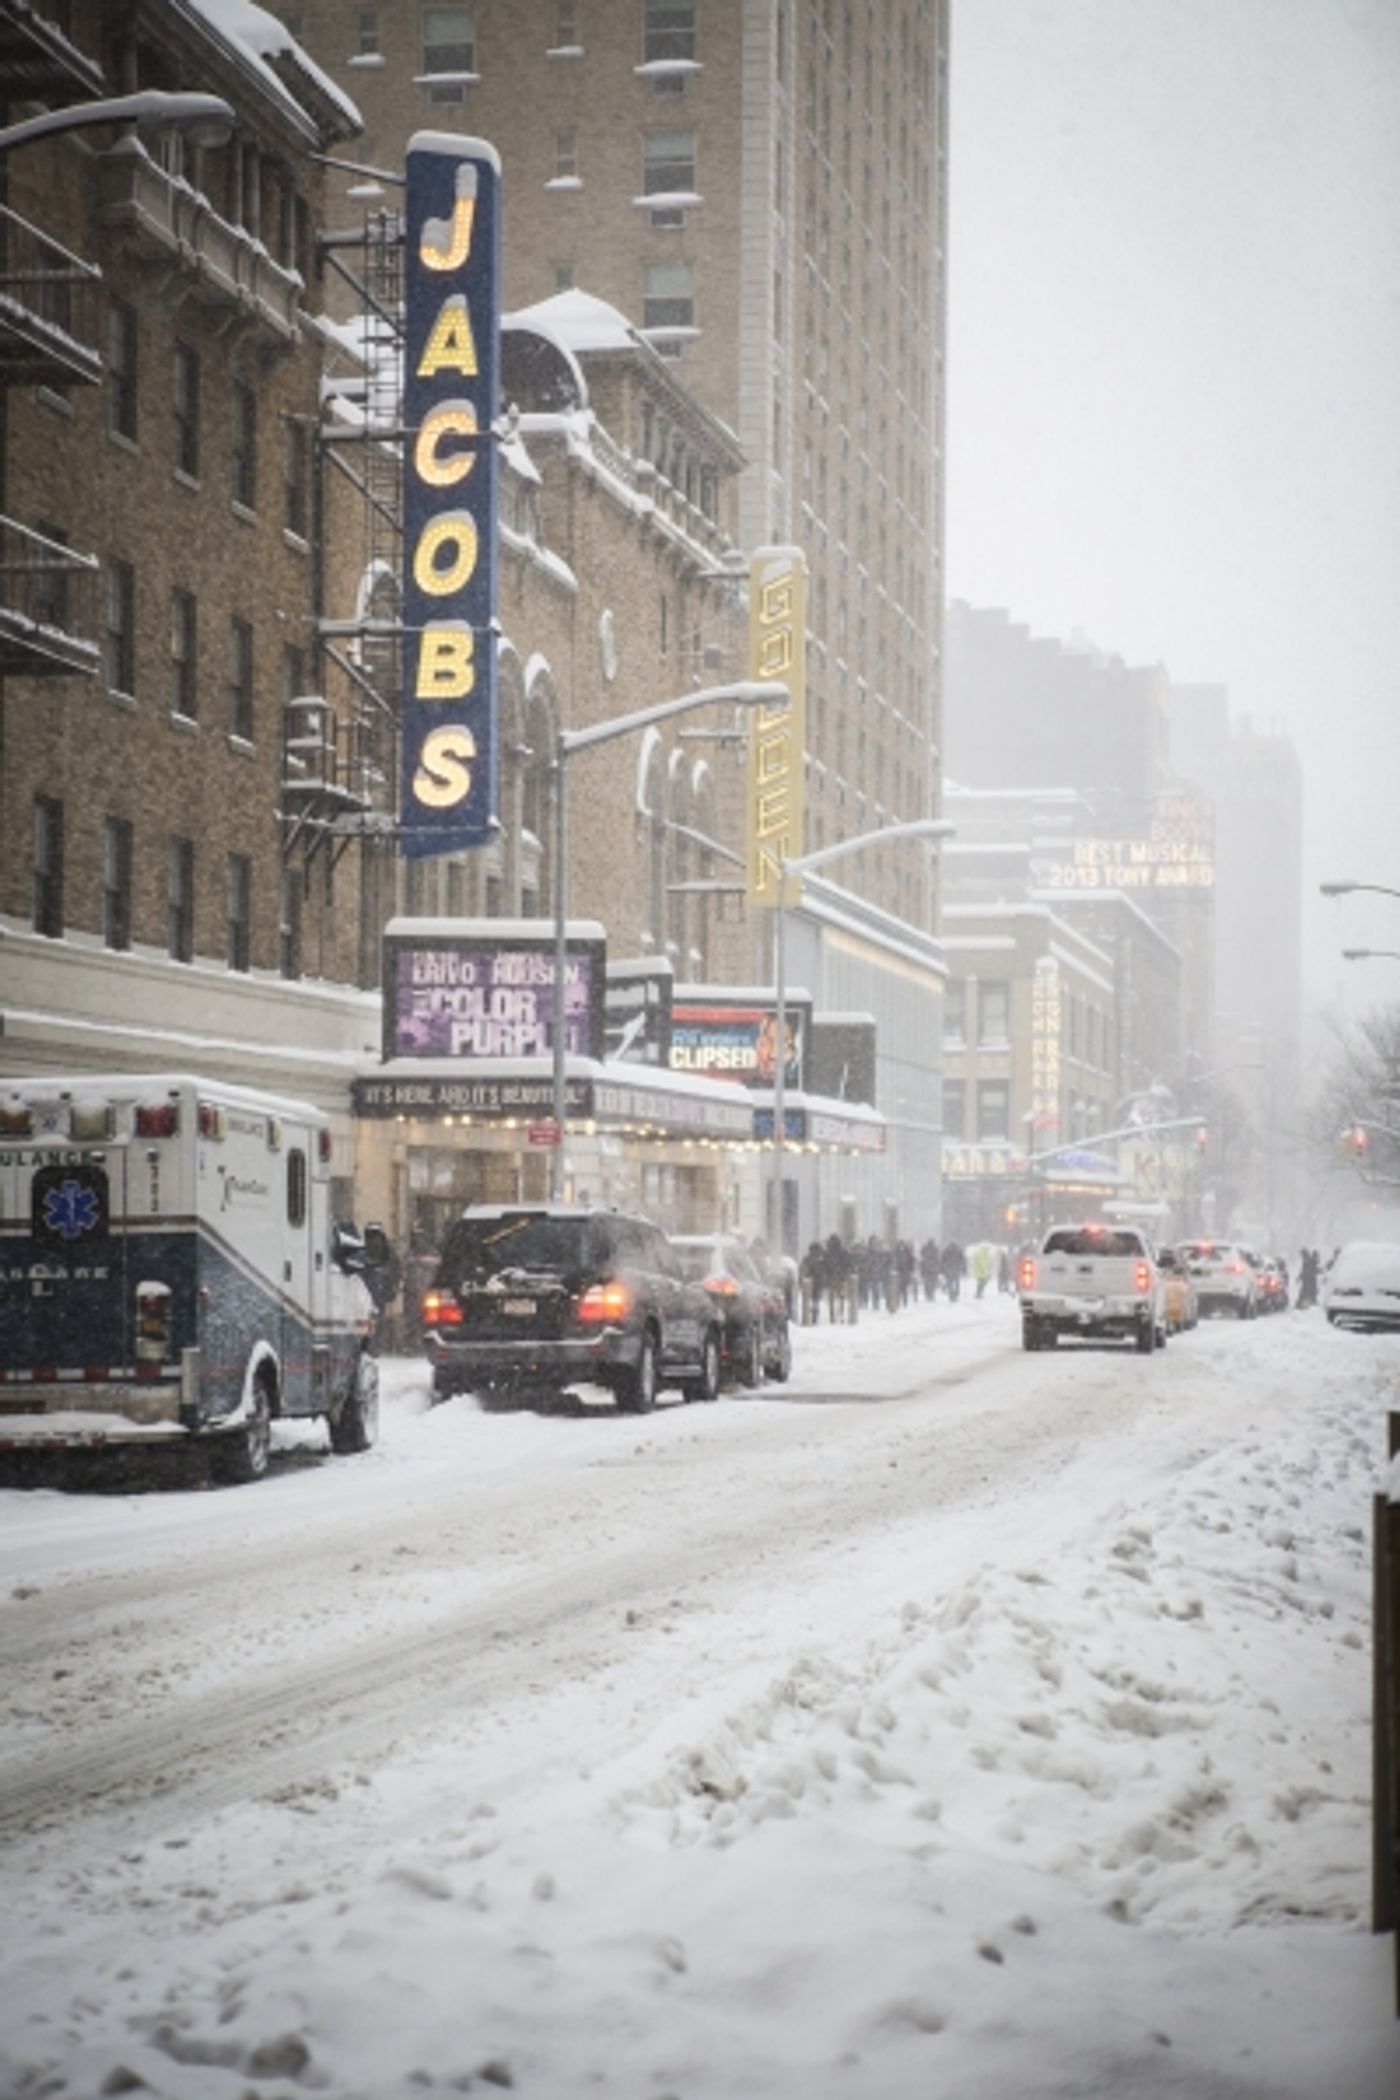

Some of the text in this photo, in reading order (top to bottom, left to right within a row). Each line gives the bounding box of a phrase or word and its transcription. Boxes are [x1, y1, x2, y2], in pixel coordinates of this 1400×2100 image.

[412, 161, 480, 809] JACOBS
[1073, 841, 1213, 864] BEST MUSICAL
[1049, 865, 1099, 887] 2013
[1103, 865, 1150, 887] TONY
[431, 988, 537, 1023] COLOR
[451, 1021, 578, 1056] PURPL
